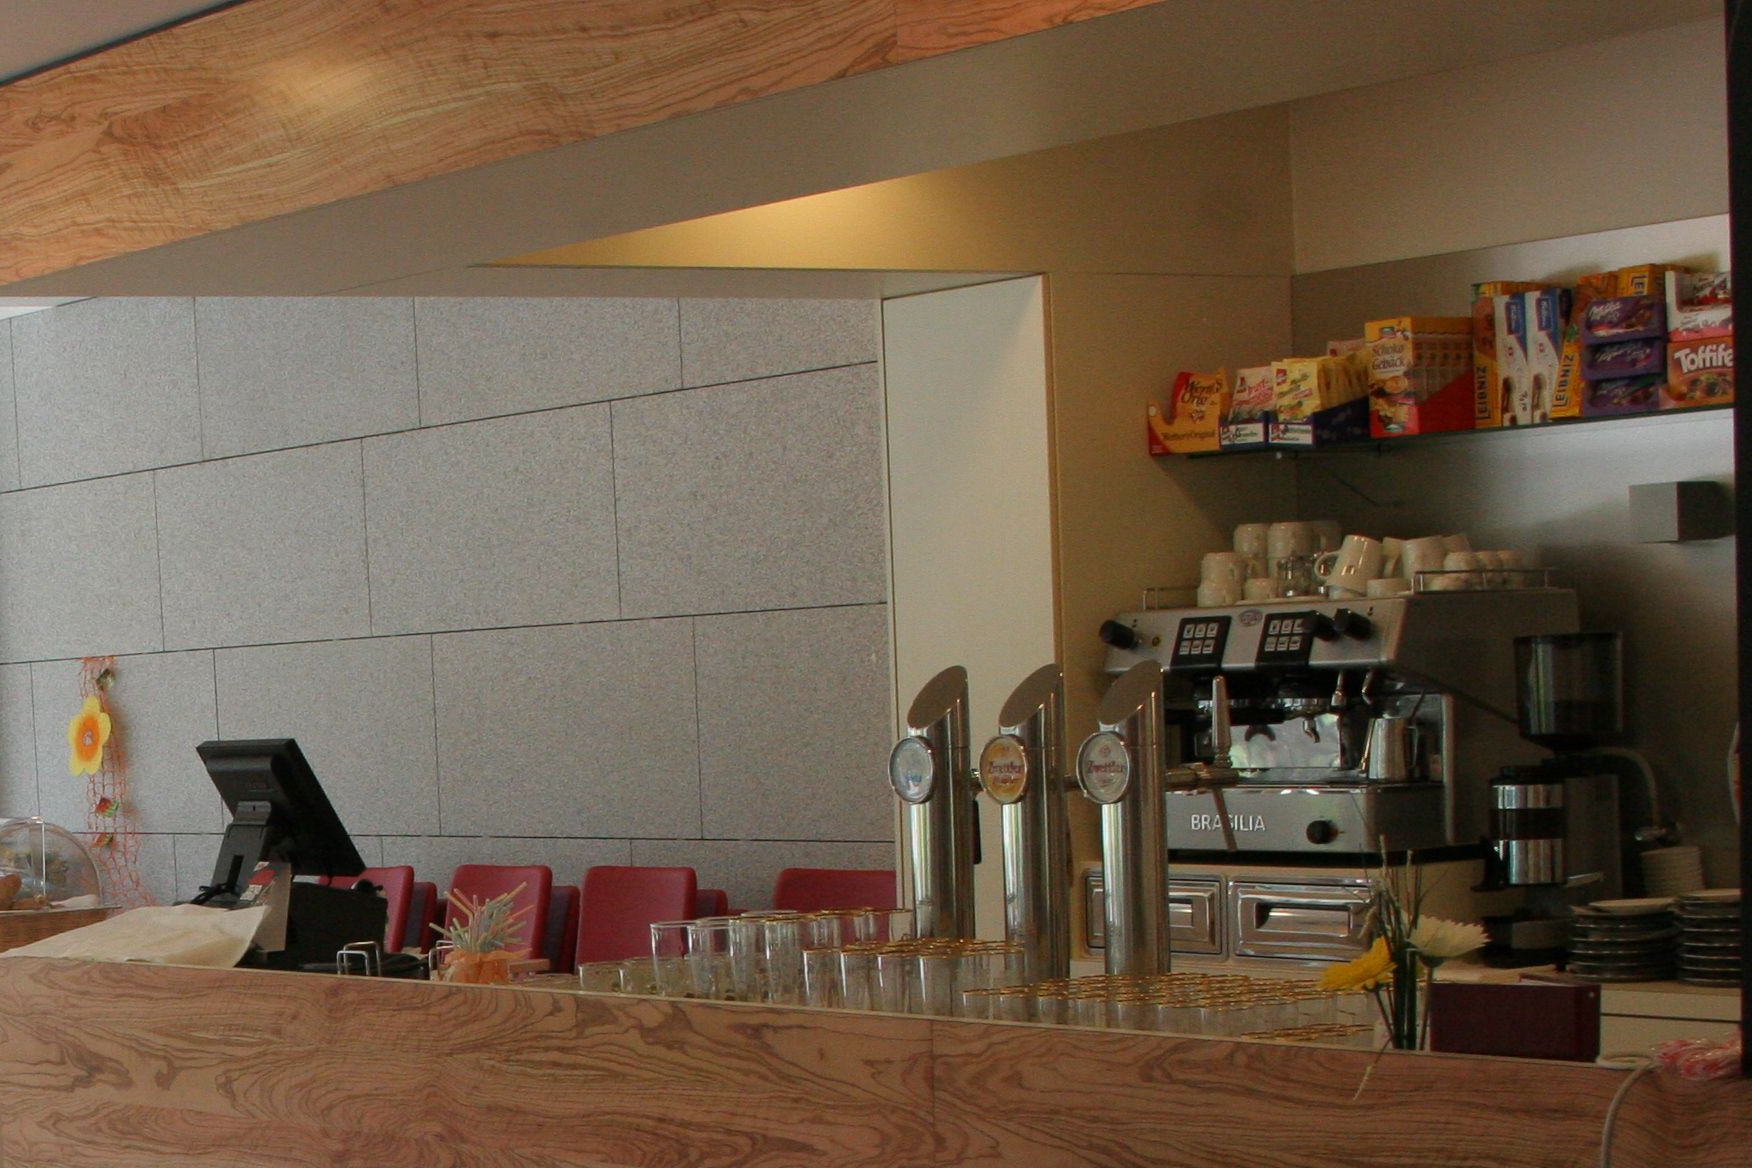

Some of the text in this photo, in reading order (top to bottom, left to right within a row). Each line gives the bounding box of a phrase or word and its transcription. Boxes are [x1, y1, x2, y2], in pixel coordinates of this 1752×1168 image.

[1552, 353, 1575, 408] LEIBNIZ
[1674, 343, 1734, 374] Toffife
[1477, 366, 1491, 419] LEIBNIZ
